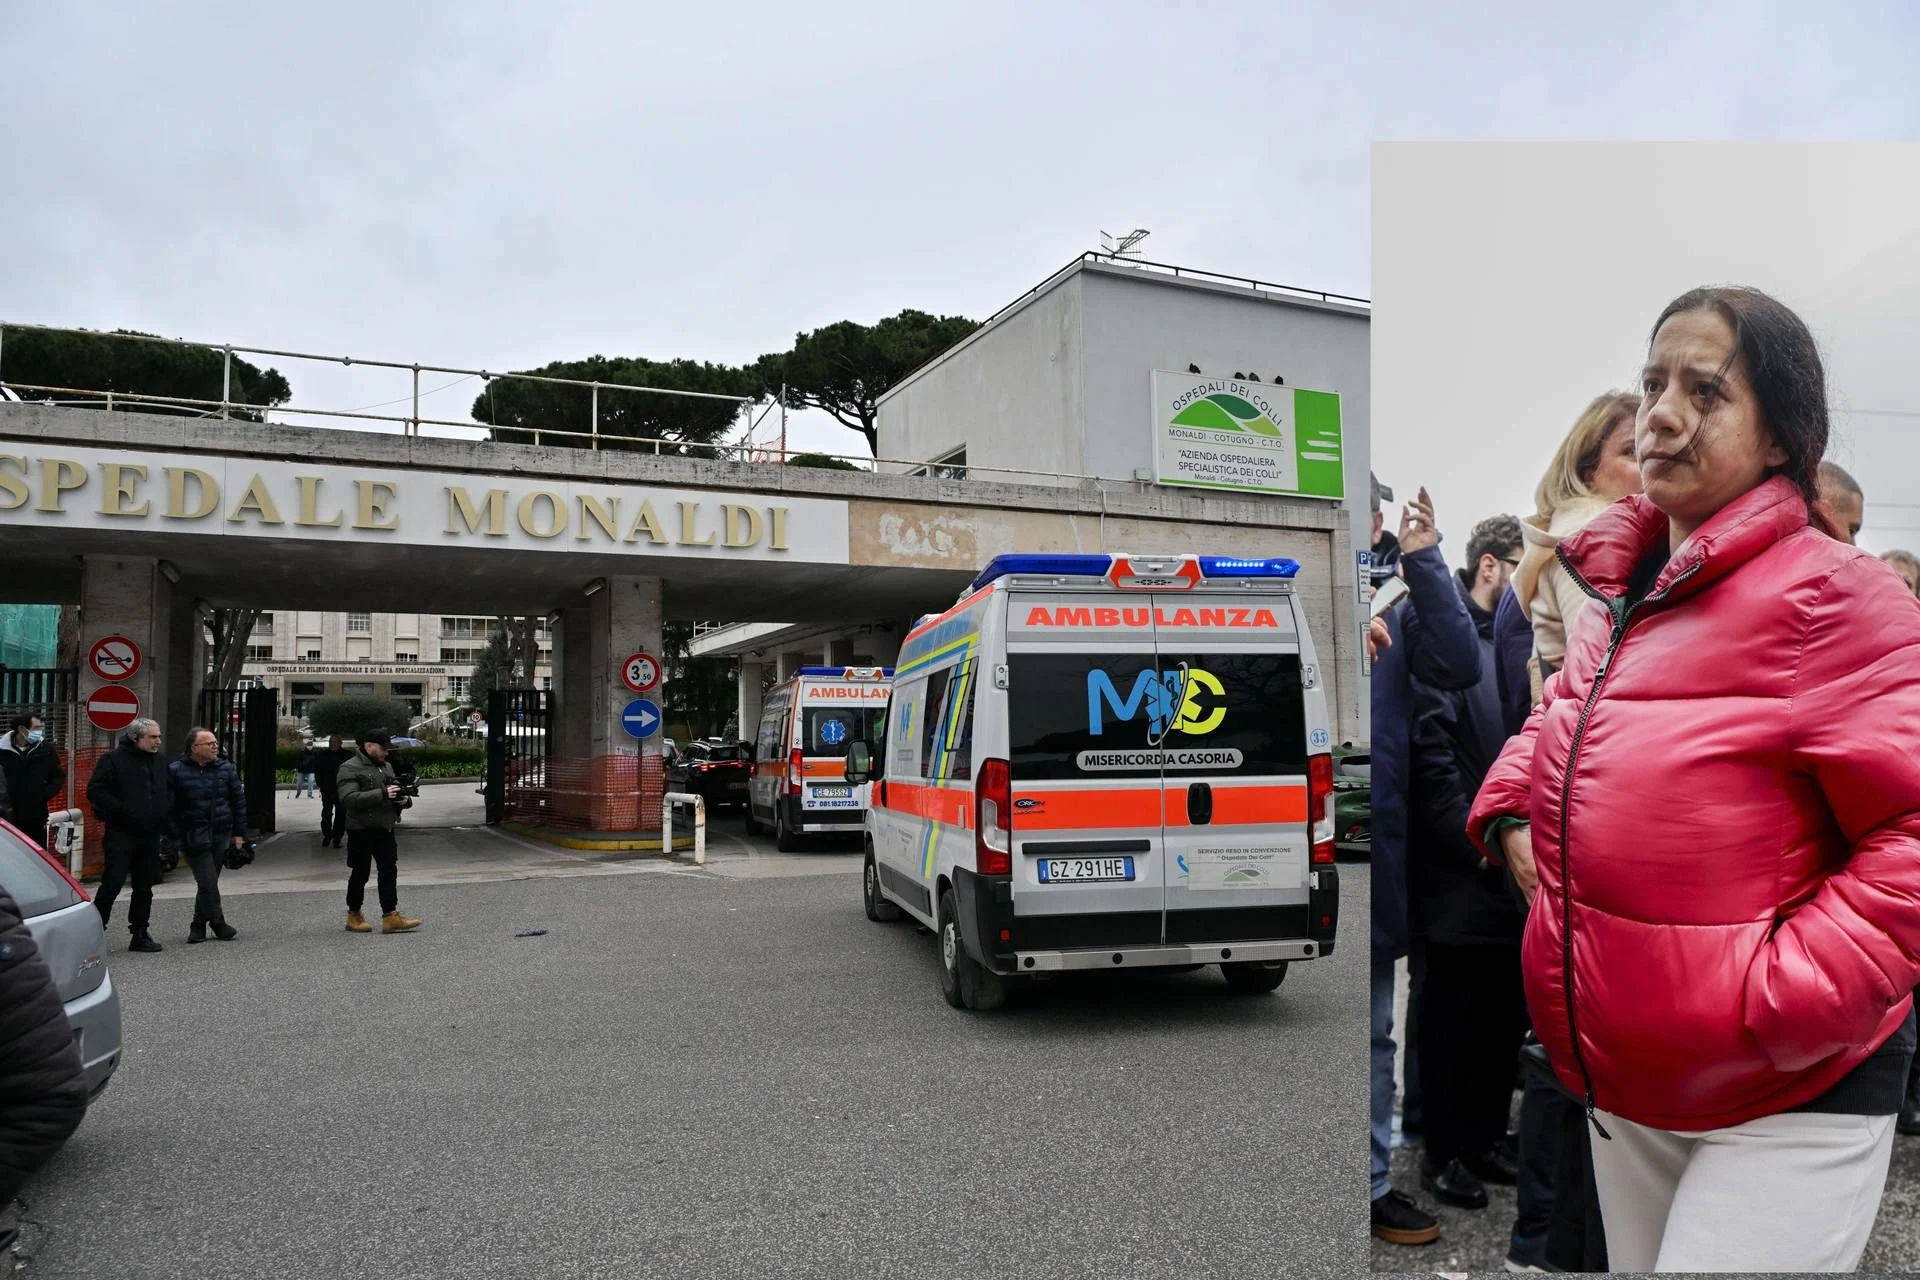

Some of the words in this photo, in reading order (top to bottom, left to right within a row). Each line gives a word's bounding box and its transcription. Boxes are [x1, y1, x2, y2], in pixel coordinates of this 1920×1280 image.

[1172, 381, 1225, 411] OSPEDALI
[1230, 382, 1250, 398] DEI
[1253, 395, 1283, 426] COLLI
[1168, 429, 1206, 440] MONALDI
[1214, 434, 1254, 445] COTUGNO
[1261, 439, 1284, 448] C.T.O.
[1220, 453, 1276, 467] OSPEDALIERA
[1178, 461, 1238, 475] SPECIALISTICA
[1240, 467, 1254, 477] DEI
[1194, 473, 1216, 481] Monaldi
[1220, 475, 1244, 485] Cotugno
[443, 486, 790, 551] MONALDI
[1360, 554, 1367, 563] P
[1026, 607, 1280, 628] AMBULANZA
[1313, 731, 1326, 743] 35
[1084, 754, 1176, 766] MISERICORDIA
[1178, 753, 1235, 764] CASORIA
